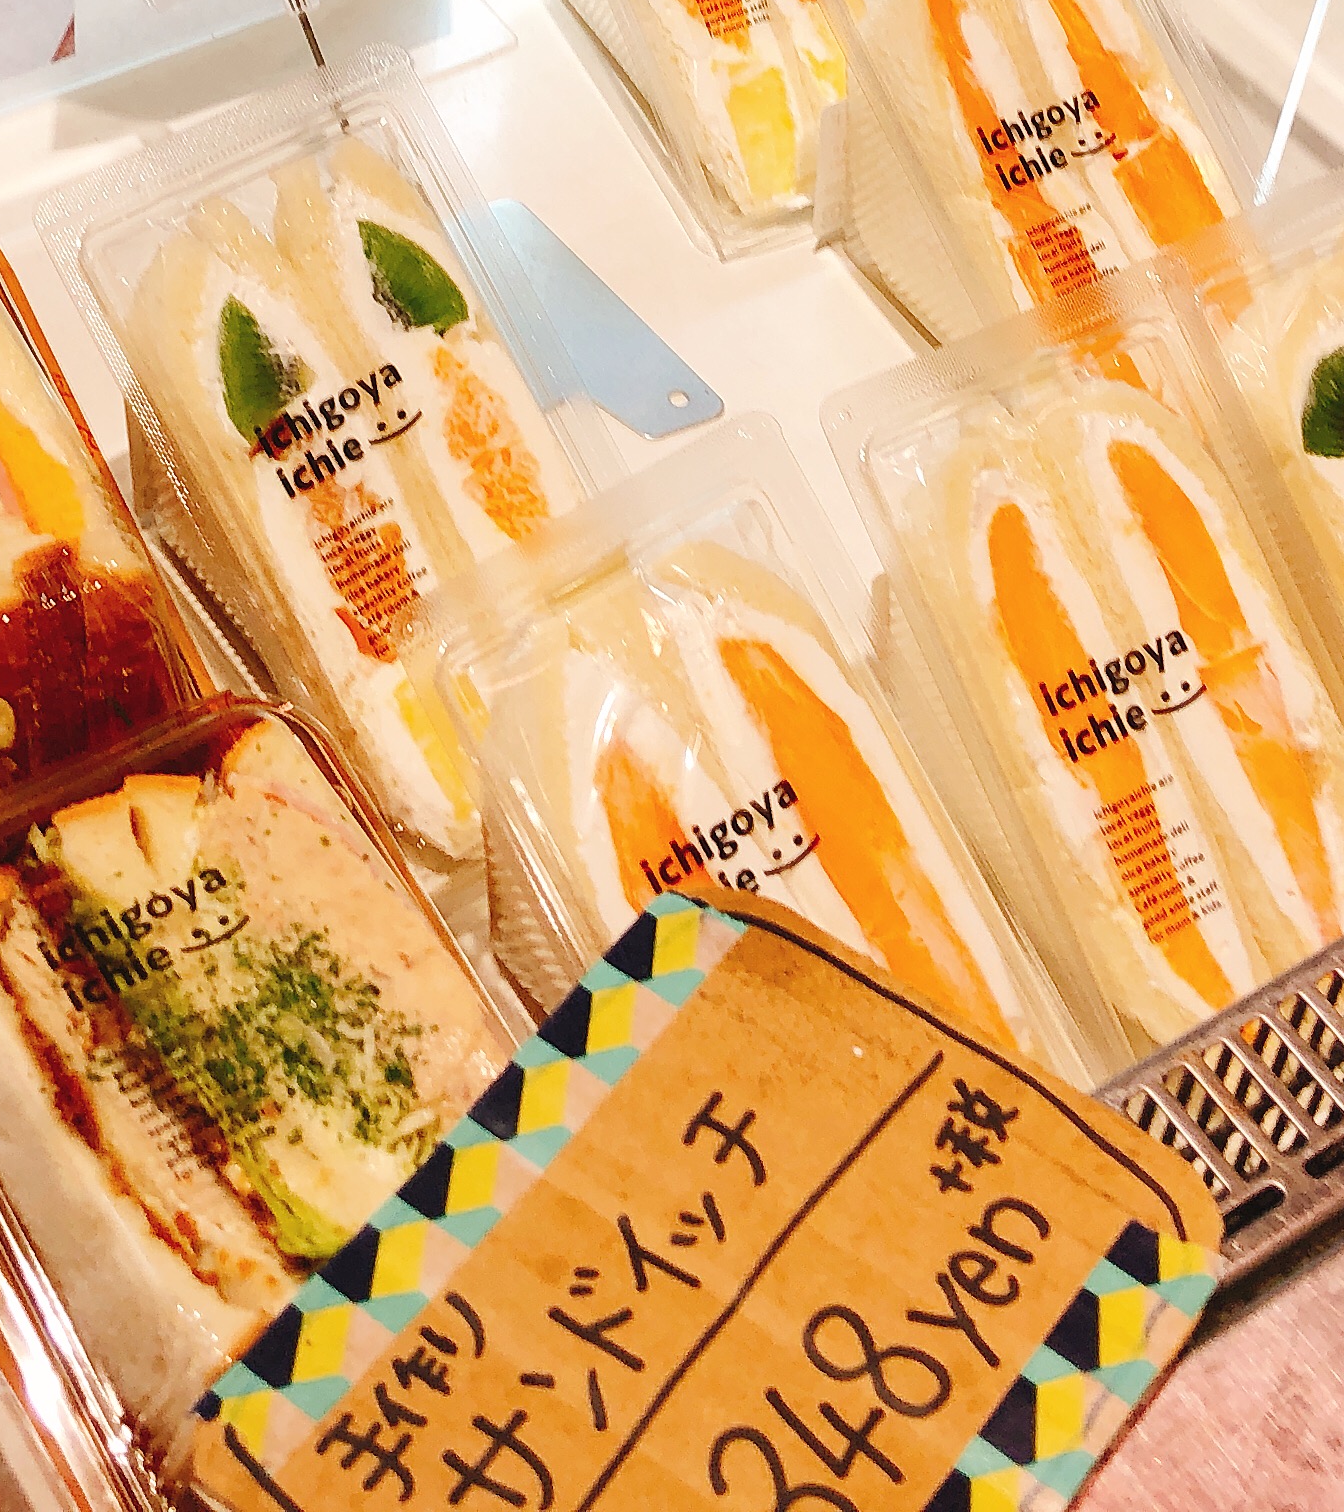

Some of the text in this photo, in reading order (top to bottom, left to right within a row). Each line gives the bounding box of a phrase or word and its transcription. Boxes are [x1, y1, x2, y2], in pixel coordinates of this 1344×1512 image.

[253, 363, 405, 463] ichigoya
[277, 434, 365, 502] ichie
[1038, 625, 1191, 718] ichigoya
[1059, 701, 1150, 766] ichie
[639, 776, 801, 890] ichigoya
[441, 1090, 768, 1510] サンドイッチ
[316, 1291, 487, 1504] 手作り
